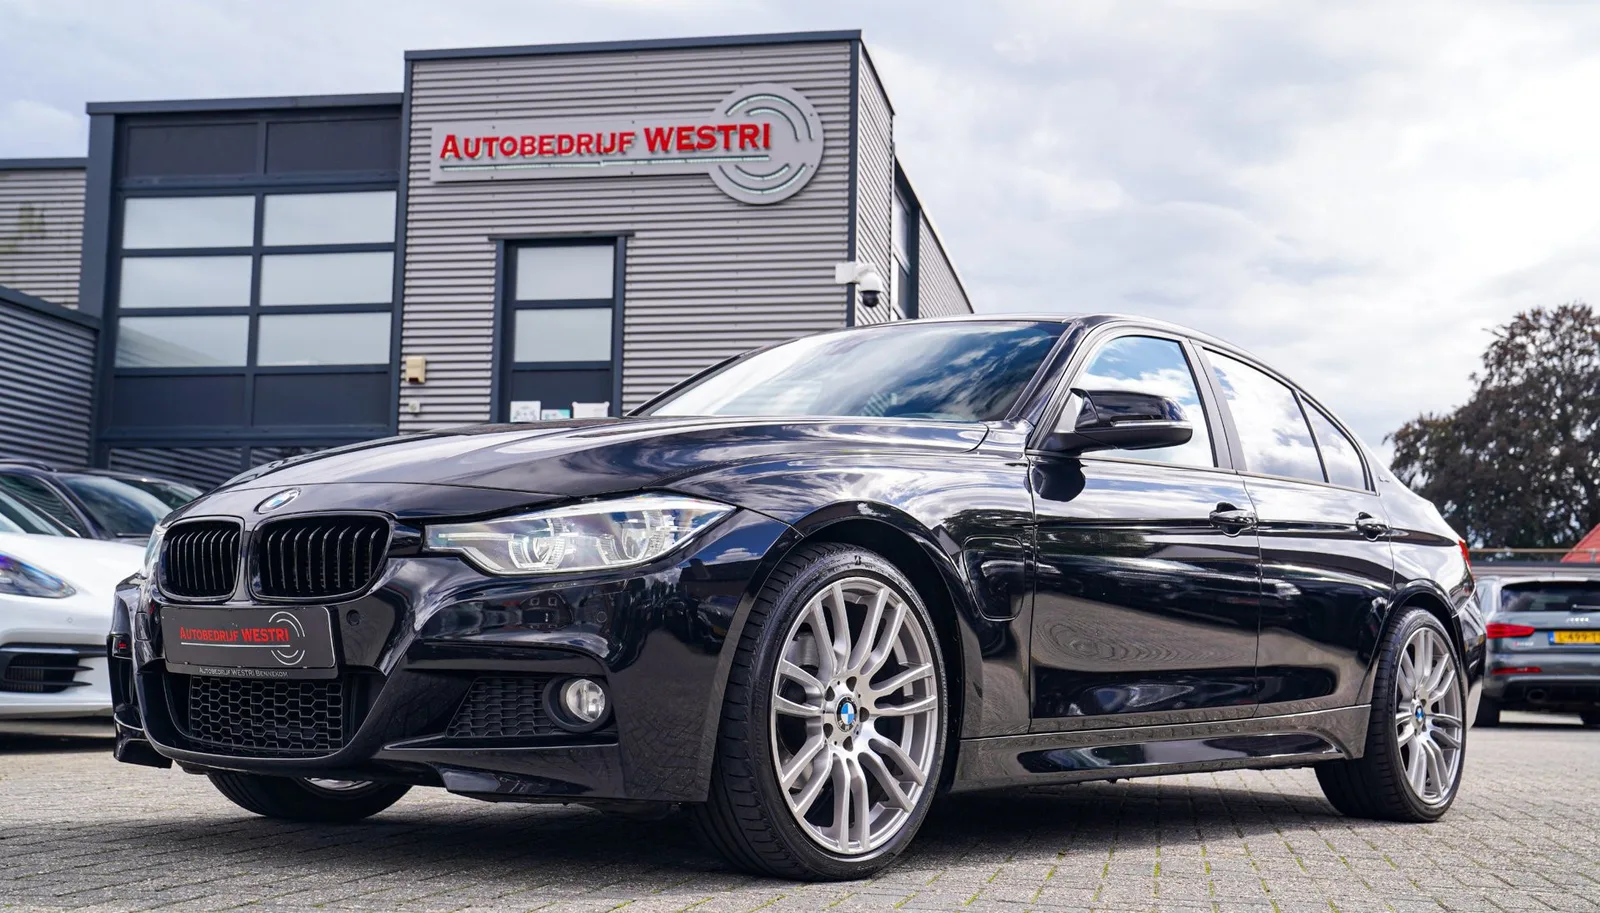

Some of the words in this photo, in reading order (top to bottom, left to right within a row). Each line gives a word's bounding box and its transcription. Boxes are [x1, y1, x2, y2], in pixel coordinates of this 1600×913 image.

[440, 131, 635, 159] AUTOBEDRIJF
[643, 122, 771, 153] WESTRI
[179, 626, 239, 642] AUTOBEDRIJF
[240, 627, 290, 643] WESTRI
[199, 667, 231, 675] AUTOBEDRIJF
[231, 669, 255, 677] WESTRI
